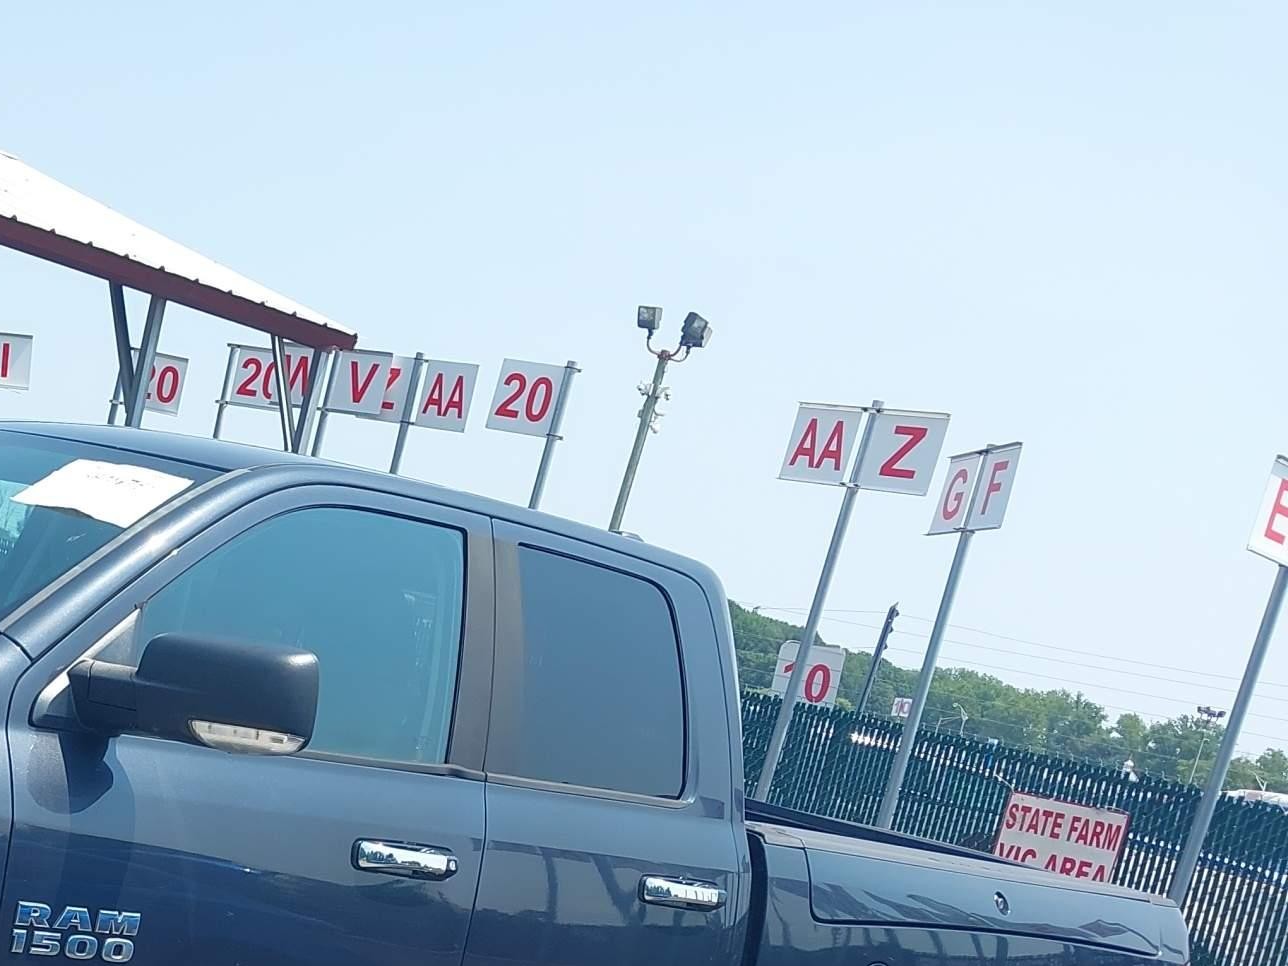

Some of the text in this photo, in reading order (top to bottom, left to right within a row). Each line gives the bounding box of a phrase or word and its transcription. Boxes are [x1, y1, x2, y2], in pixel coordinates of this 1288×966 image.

[350, 360, 380, 404] V
[422, 371, 465, 420] AA
[493, 371, 554, 423] 20
[788, 417, 845, 472] AA
[878, 425, 929, 480] Z
[941, 468, 969, 521] G
[979, 459, 1010, 516] F
[1005, 803, 1122, 852] STATE FARM
[14, 900, 143, 937] RAM
[11, 928, 136, 964] 1500
